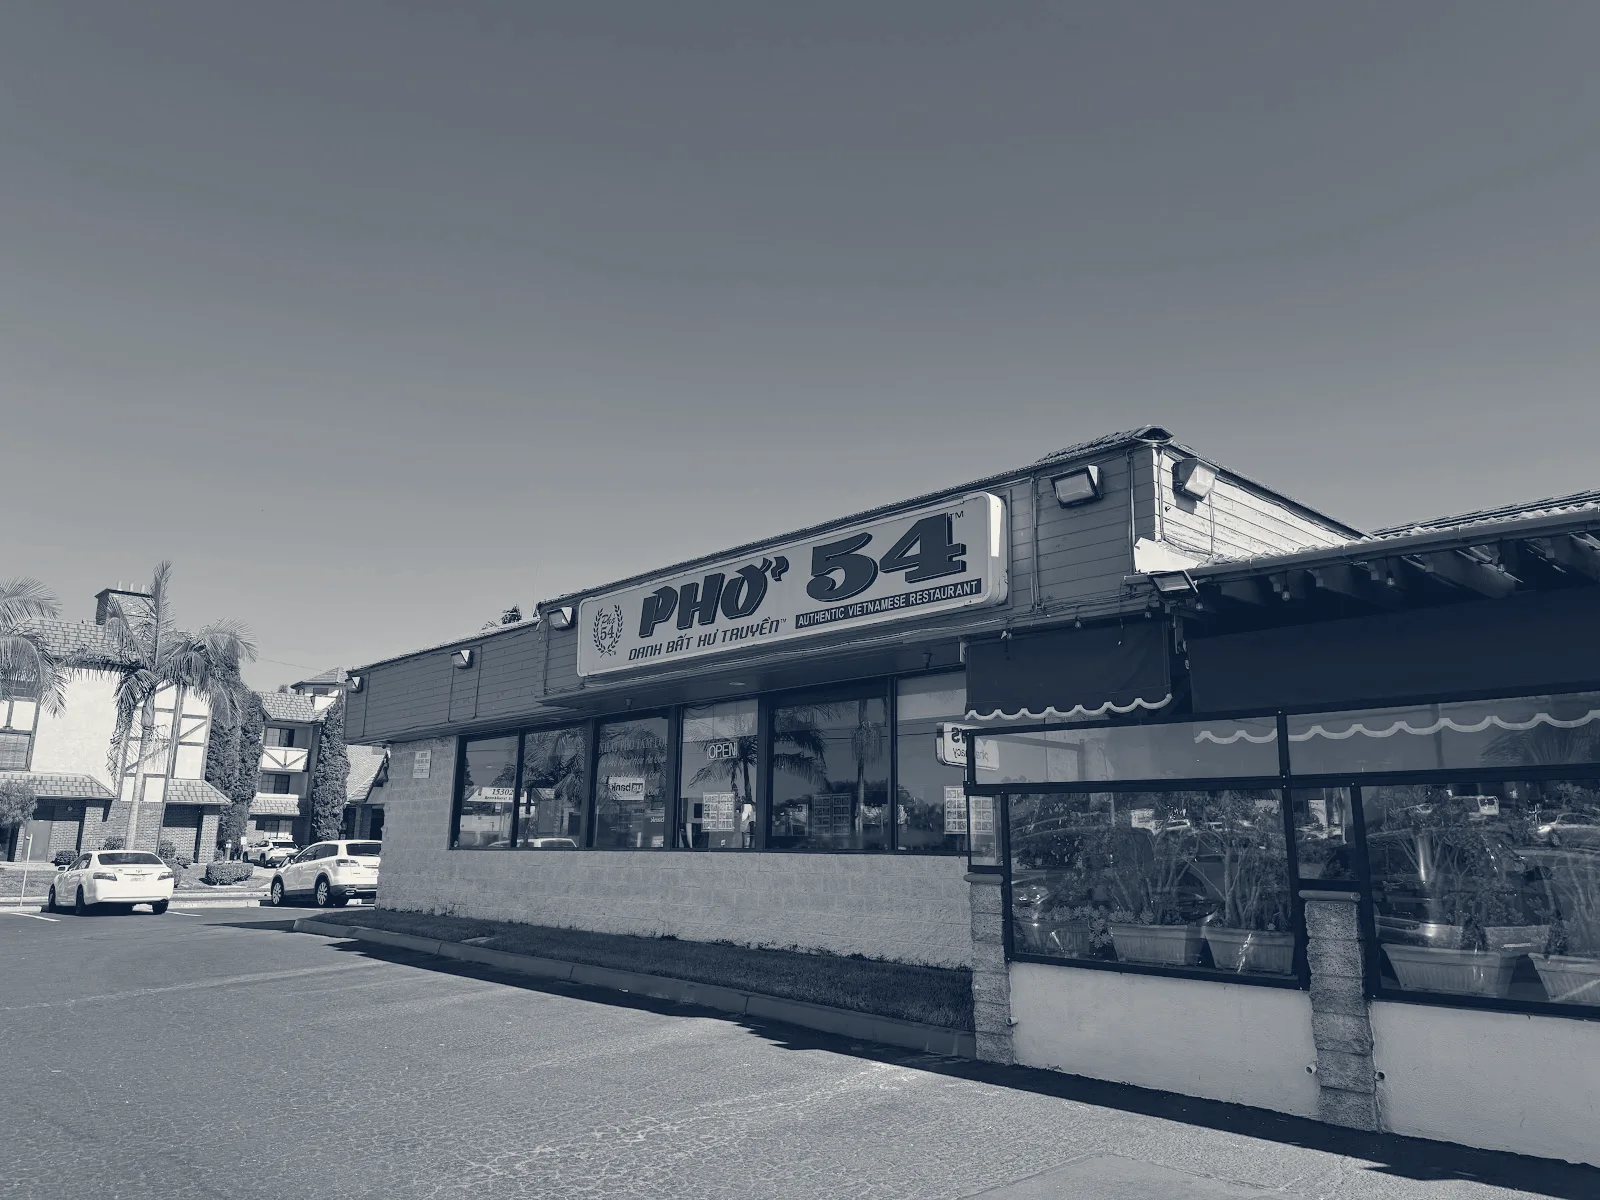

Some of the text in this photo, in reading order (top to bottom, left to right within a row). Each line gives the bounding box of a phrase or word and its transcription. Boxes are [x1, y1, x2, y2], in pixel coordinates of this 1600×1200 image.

[806, 513, 967, 602] 54
[797, 581, 978, 627] AUTHENTIC VIETNAMESE RESTAURANT
[600, 625, 615, 641] 54
[628, 643, 663, 661] DANH
[709, 742, 736, 759] OPEN
[492, 788, 514, 796] 15302
